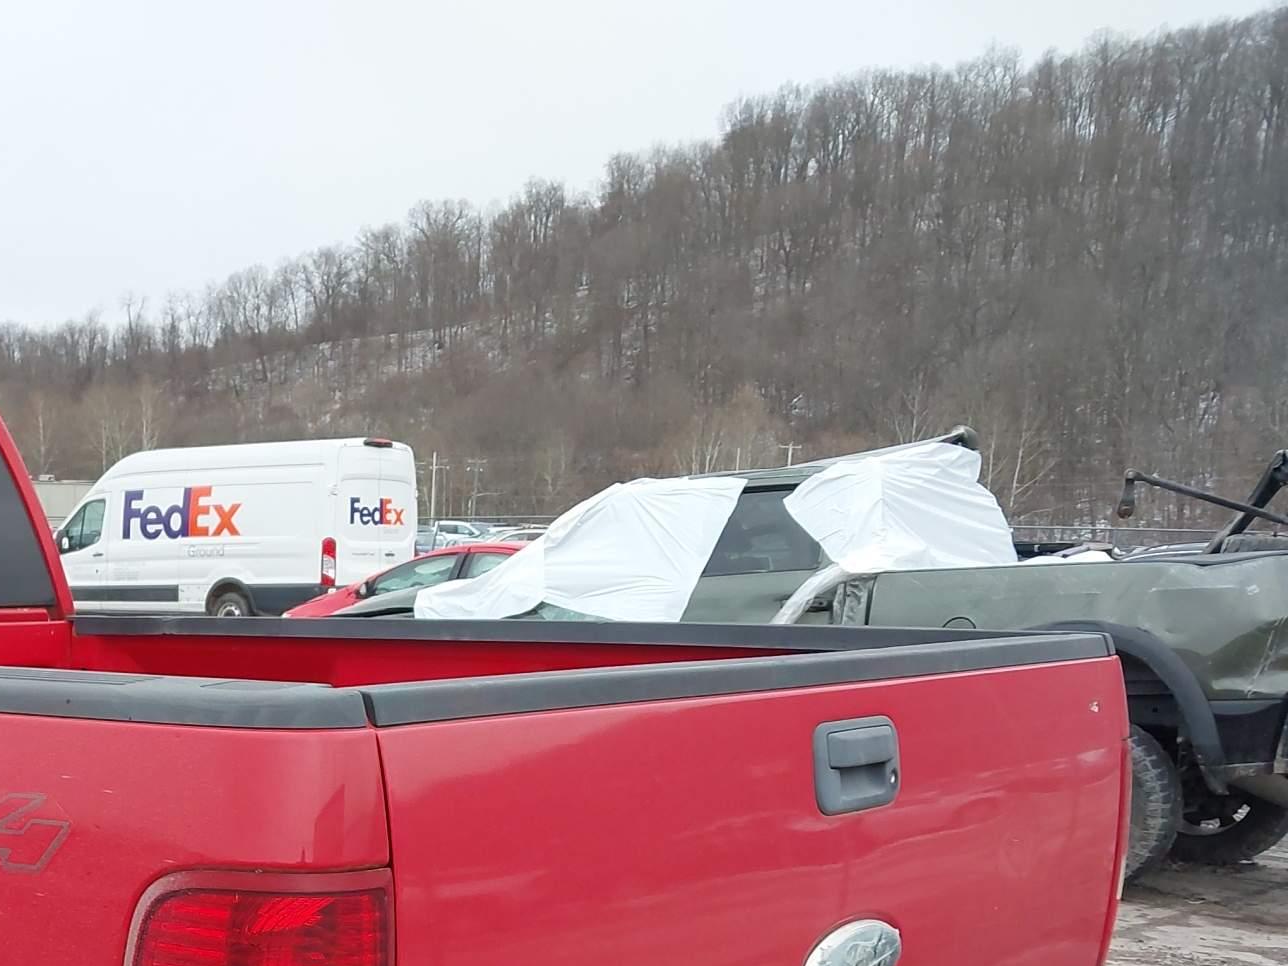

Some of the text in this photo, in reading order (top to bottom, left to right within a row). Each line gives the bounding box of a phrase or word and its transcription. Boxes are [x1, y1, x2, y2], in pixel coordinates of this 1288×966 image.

[122, 485, 242, 541] FedEx
[349, 497, 404, 527] FedEx
[187, 544, 225, 558] Ground
